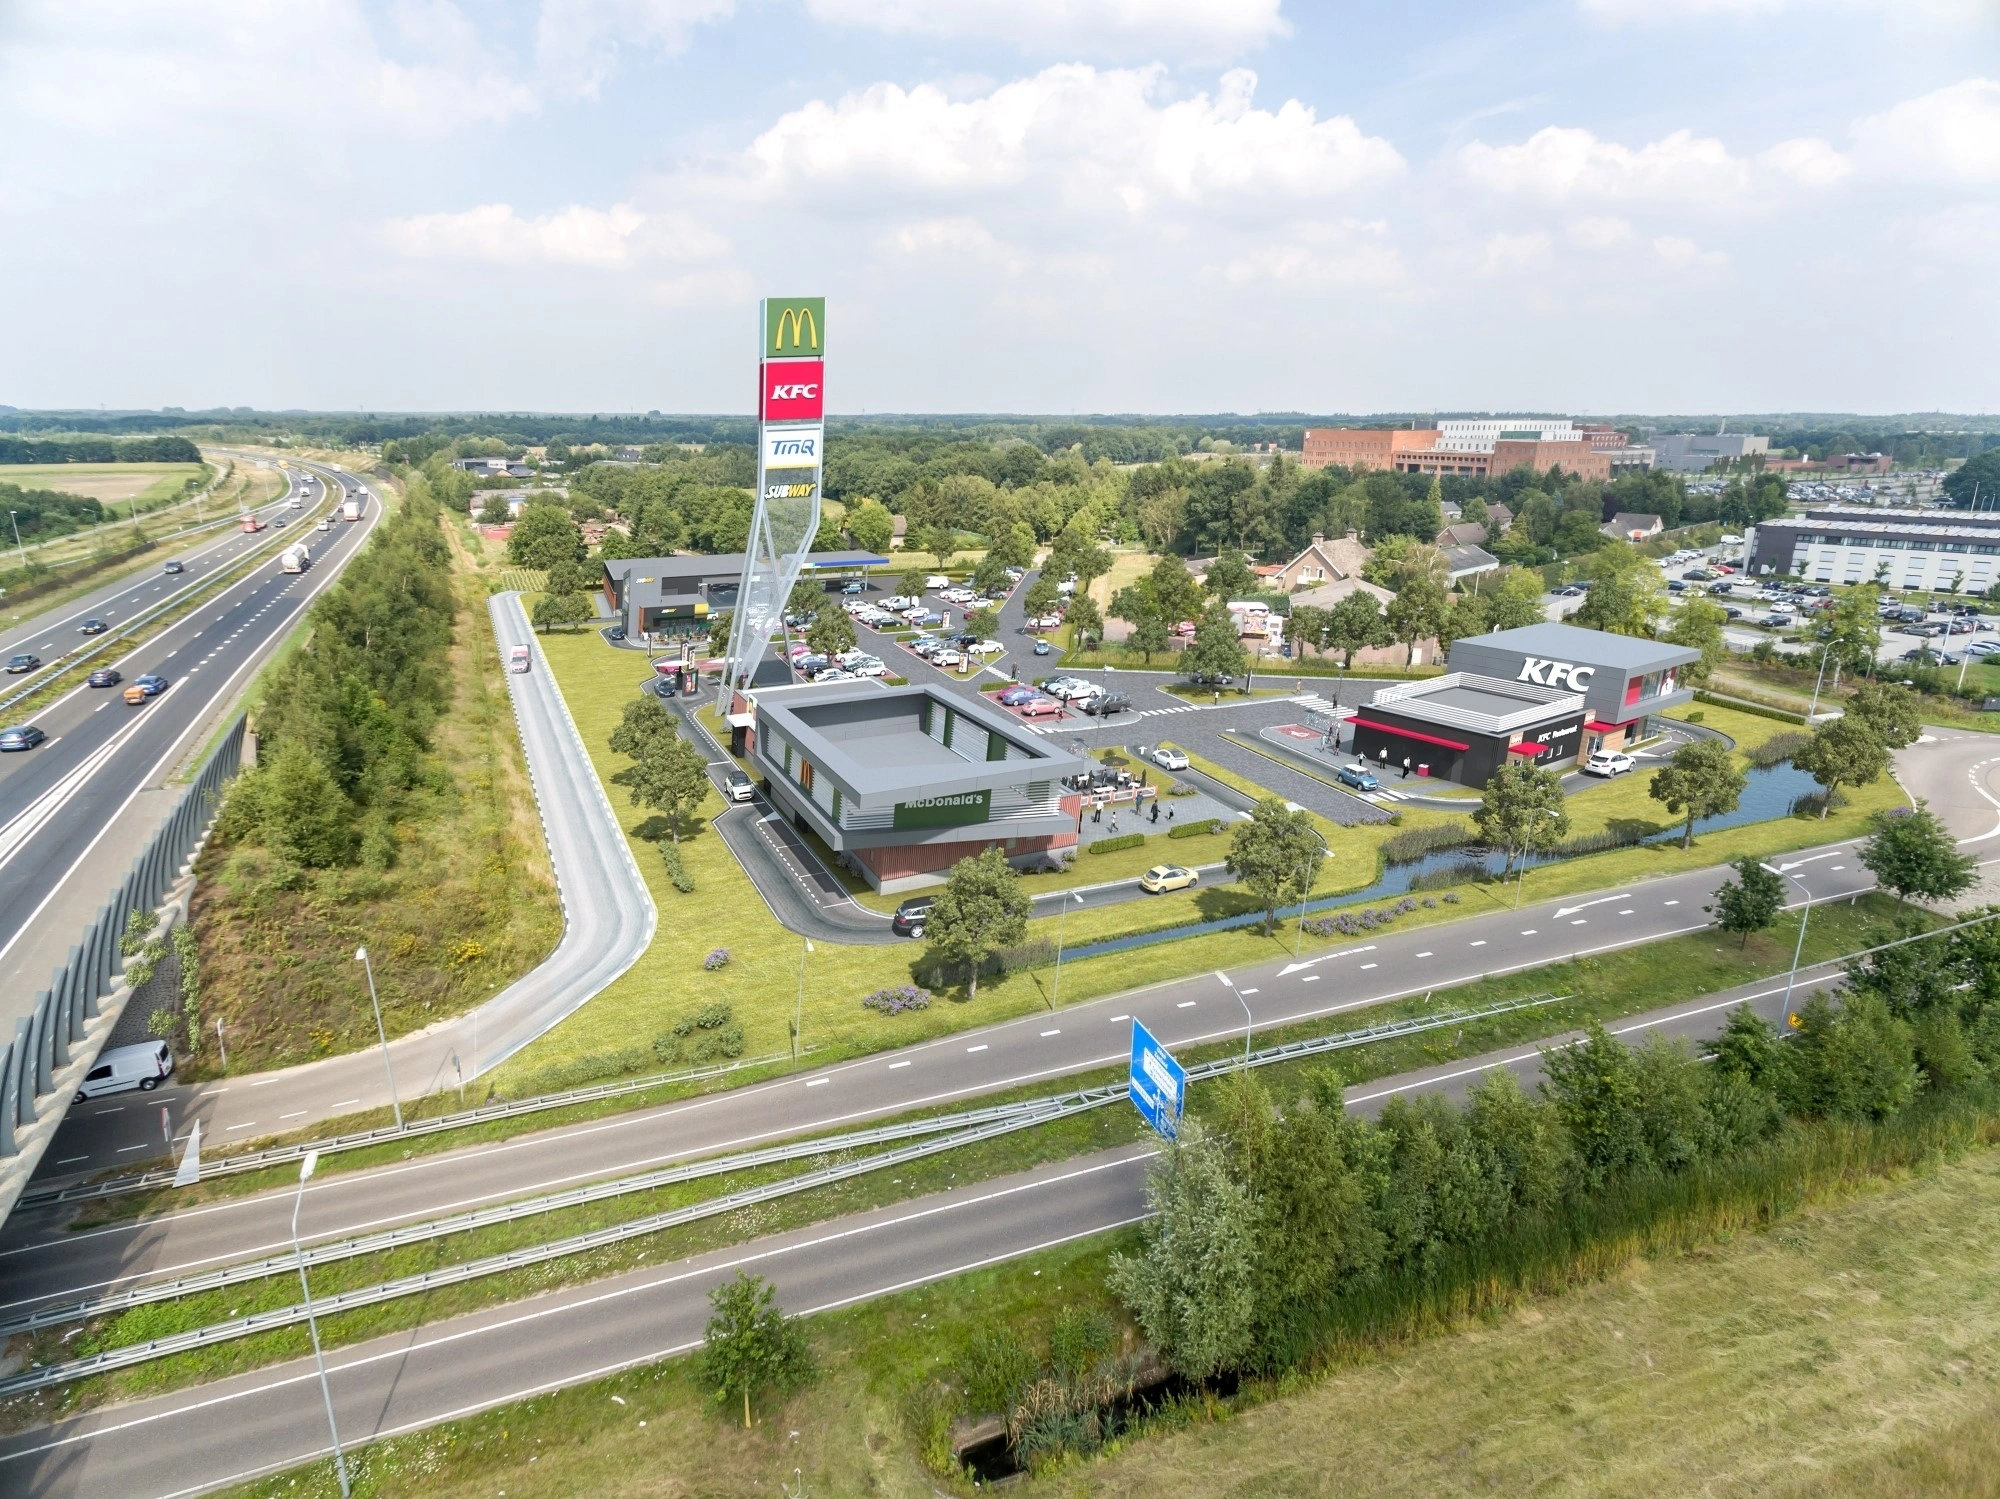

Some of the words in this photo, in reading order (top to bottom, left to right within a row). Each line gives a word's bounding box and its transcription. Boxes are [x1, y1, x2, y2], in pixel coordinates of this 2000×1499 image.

[771, 383, 818, 401] KFC
[764, 482, 817, 500] SUBWAY
[1516, 656, 1596, 692] KFC
[904, 793, 984, 809] McDonald's
